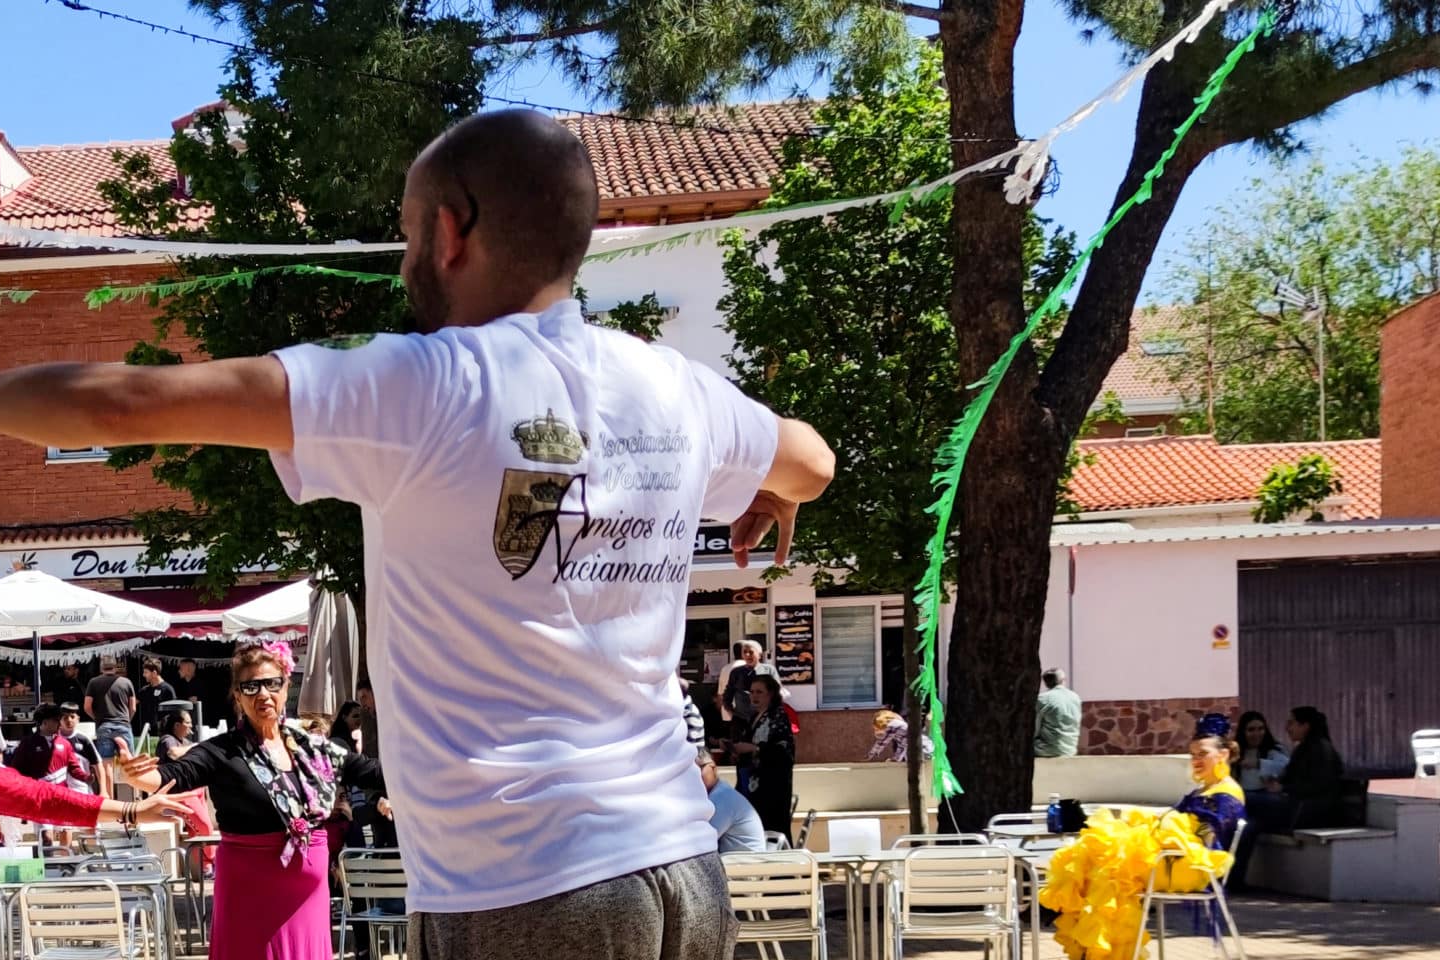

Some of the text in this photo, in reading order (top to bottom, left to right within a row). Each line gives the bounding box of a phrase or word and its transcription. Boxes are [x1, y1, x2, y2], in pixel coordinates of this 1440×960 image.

[604, 462, 682, 493] Vecinal
[662, 509, 687, 541] de
[72, 549, 129, 577] Don
